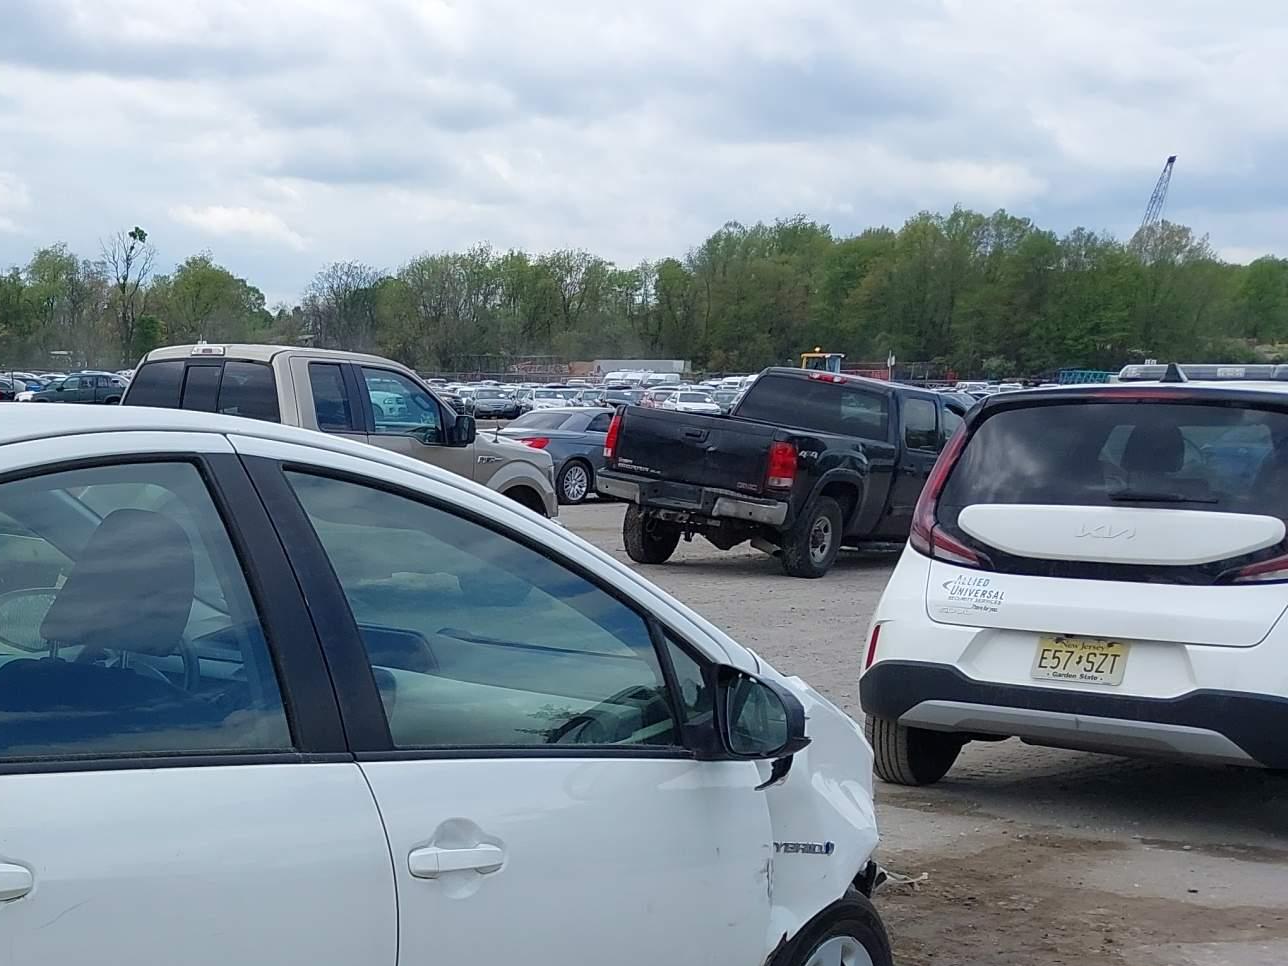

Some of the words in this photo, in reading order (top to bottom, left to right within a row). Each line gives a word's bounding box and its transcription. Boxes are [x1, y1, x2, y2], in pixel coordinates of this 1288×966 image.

[954, 574, 991, 587] ALLIED
[950, 585, 1005, 601] UNIVERSAL
[1052, 671, 1077, 679] Garden
[1079, 673, 1098, 681] State
